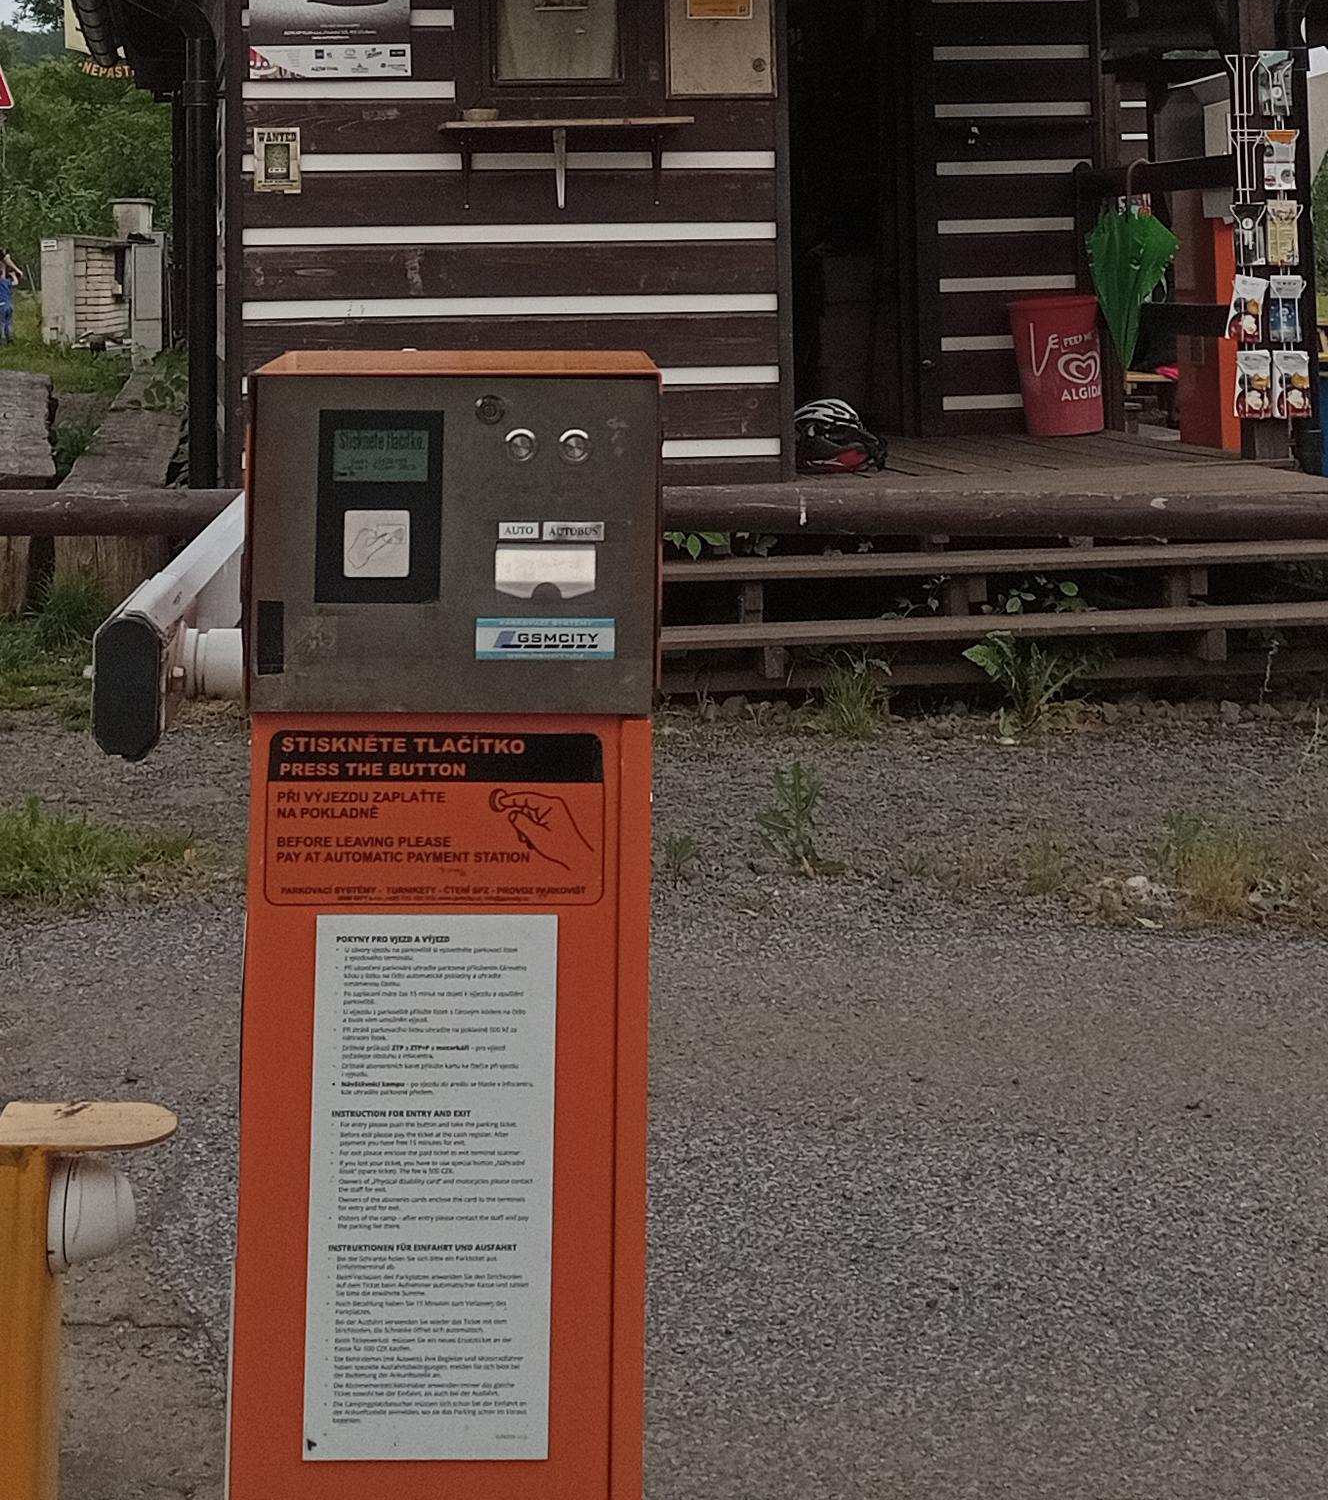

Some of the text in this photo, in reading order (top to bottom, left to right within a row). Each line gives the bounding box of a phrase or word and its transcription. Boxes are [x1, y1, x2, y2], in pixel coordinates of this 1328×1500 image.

[257, 132, 296, 142] WANTED
[504, 526, 533, 535] AUTO
[550, 527, 598, 536] AUTOBUS
[518, 633, 599, 643] GSMCITY
[281, 734, 526, 755] STISKNĚTE TLAČÍTKO
[280, 763, 466, 777] PRESS THE BUTTON
[277, 790, 446, 803] PŘI VÝJEZDU ZAPLAŤTE
[277, 805, 379, 819] NA POKLADNĚ
[277, 836, 451, 847] BEFORE LEAVING PLEASE
[276, 851, 530, 863] PAY AT AUTOMATIC PAYMENT STATION
[390, 936, 413, 944] VJEZD
[422, 934, 450, 944] VÝJEZD
[396, 1243, 412, 1251] FÜR
